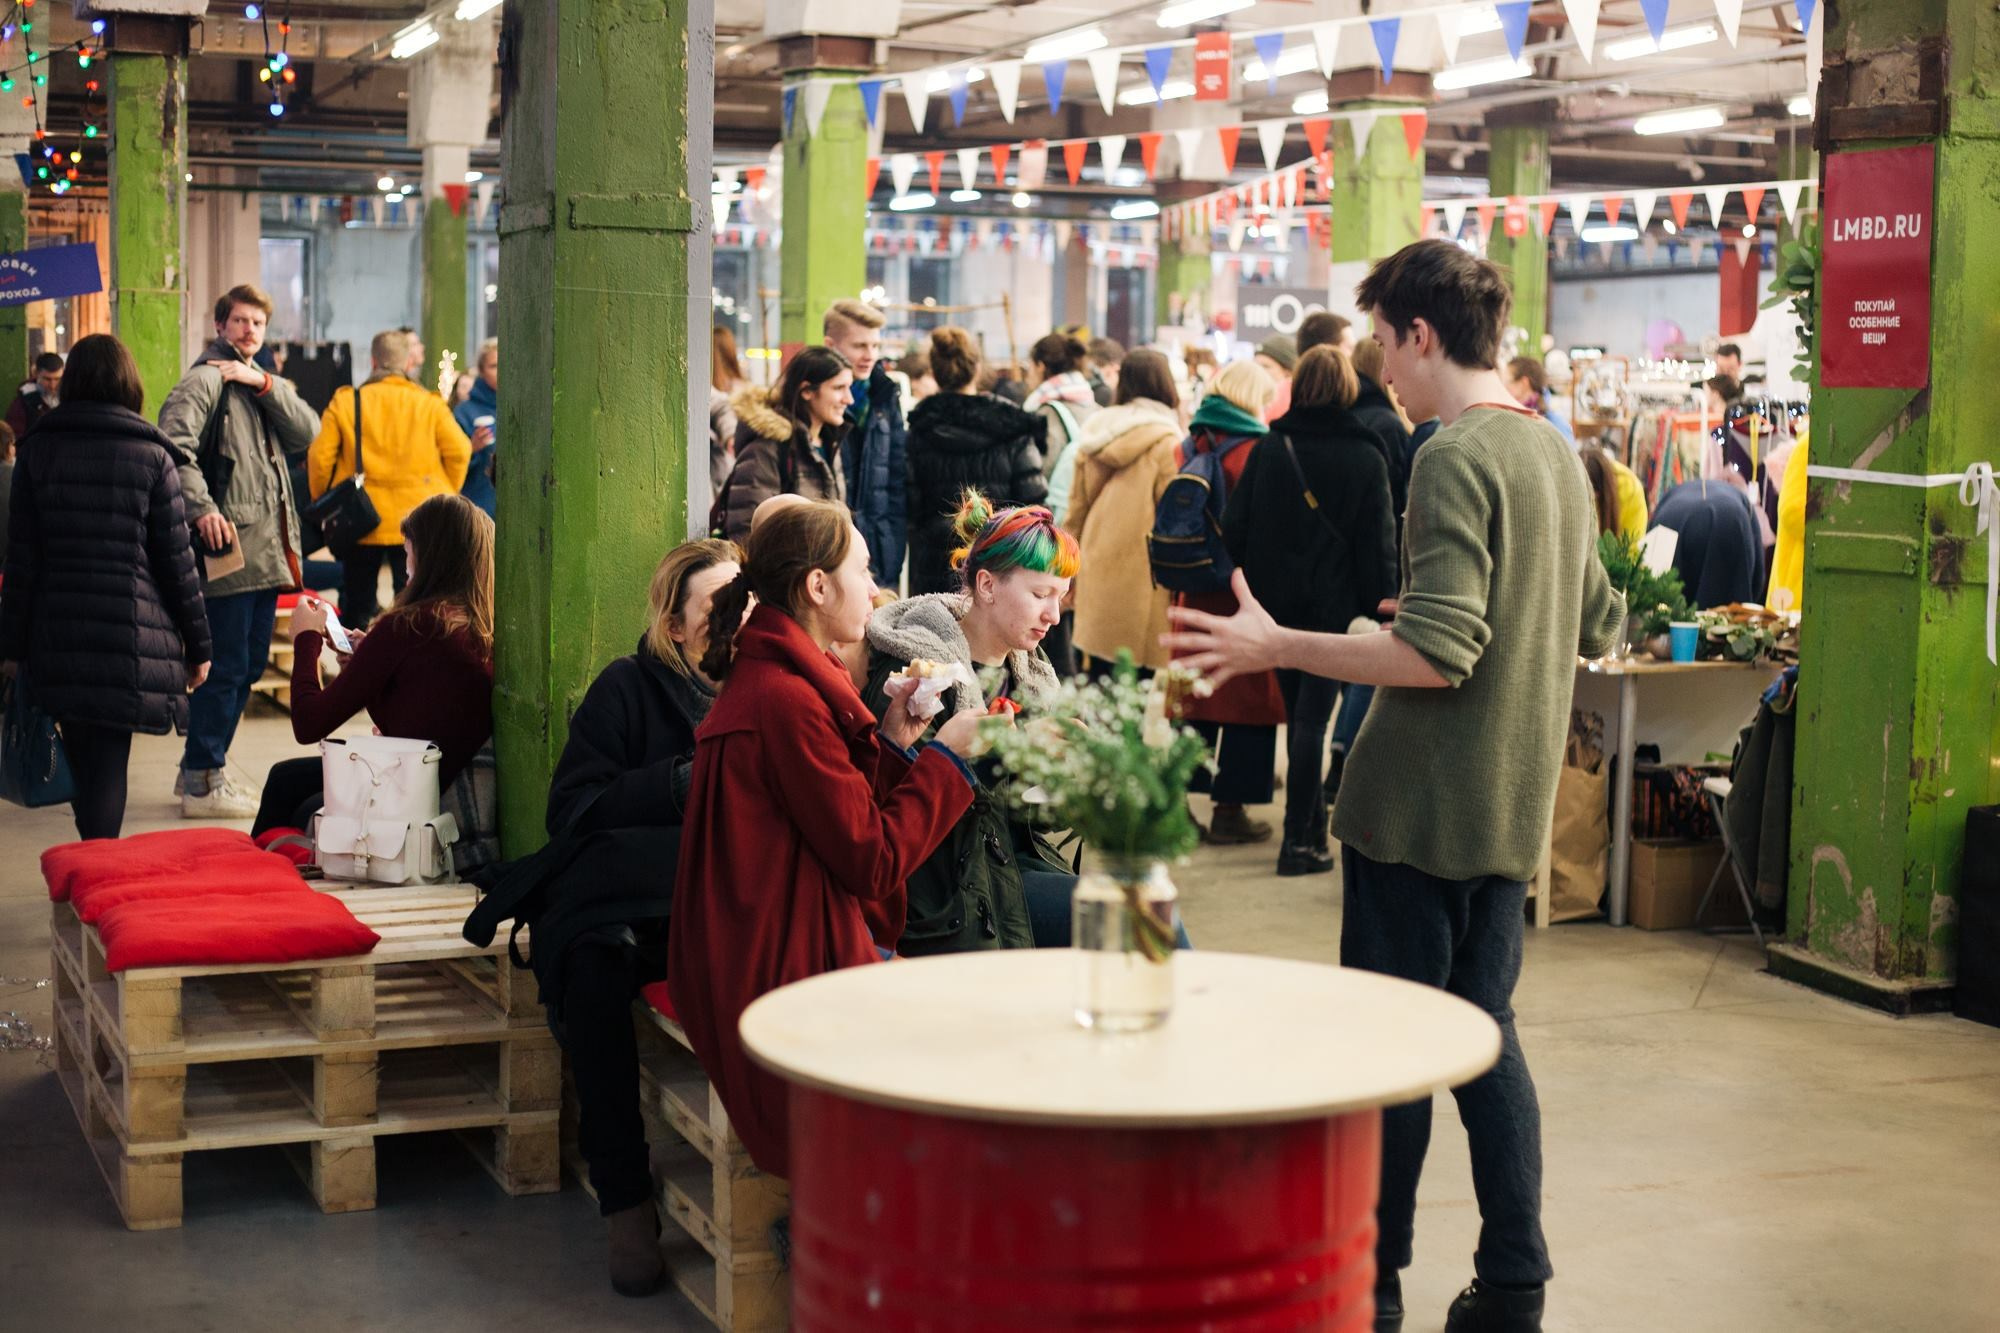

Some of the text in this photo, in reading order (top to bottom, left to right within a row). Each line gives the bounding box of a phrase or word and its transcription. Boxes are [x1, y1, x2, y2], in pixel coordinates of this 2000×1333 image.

[1833, 213, 1921, 241] LMBD.RU
[1854, 299, 1896, 312] ПОКУПАЙ
[1849, 316, 1900, 329] ОСОБЕННЫЕ
[1862, 333, 1887, 345] ВЕЩИ
